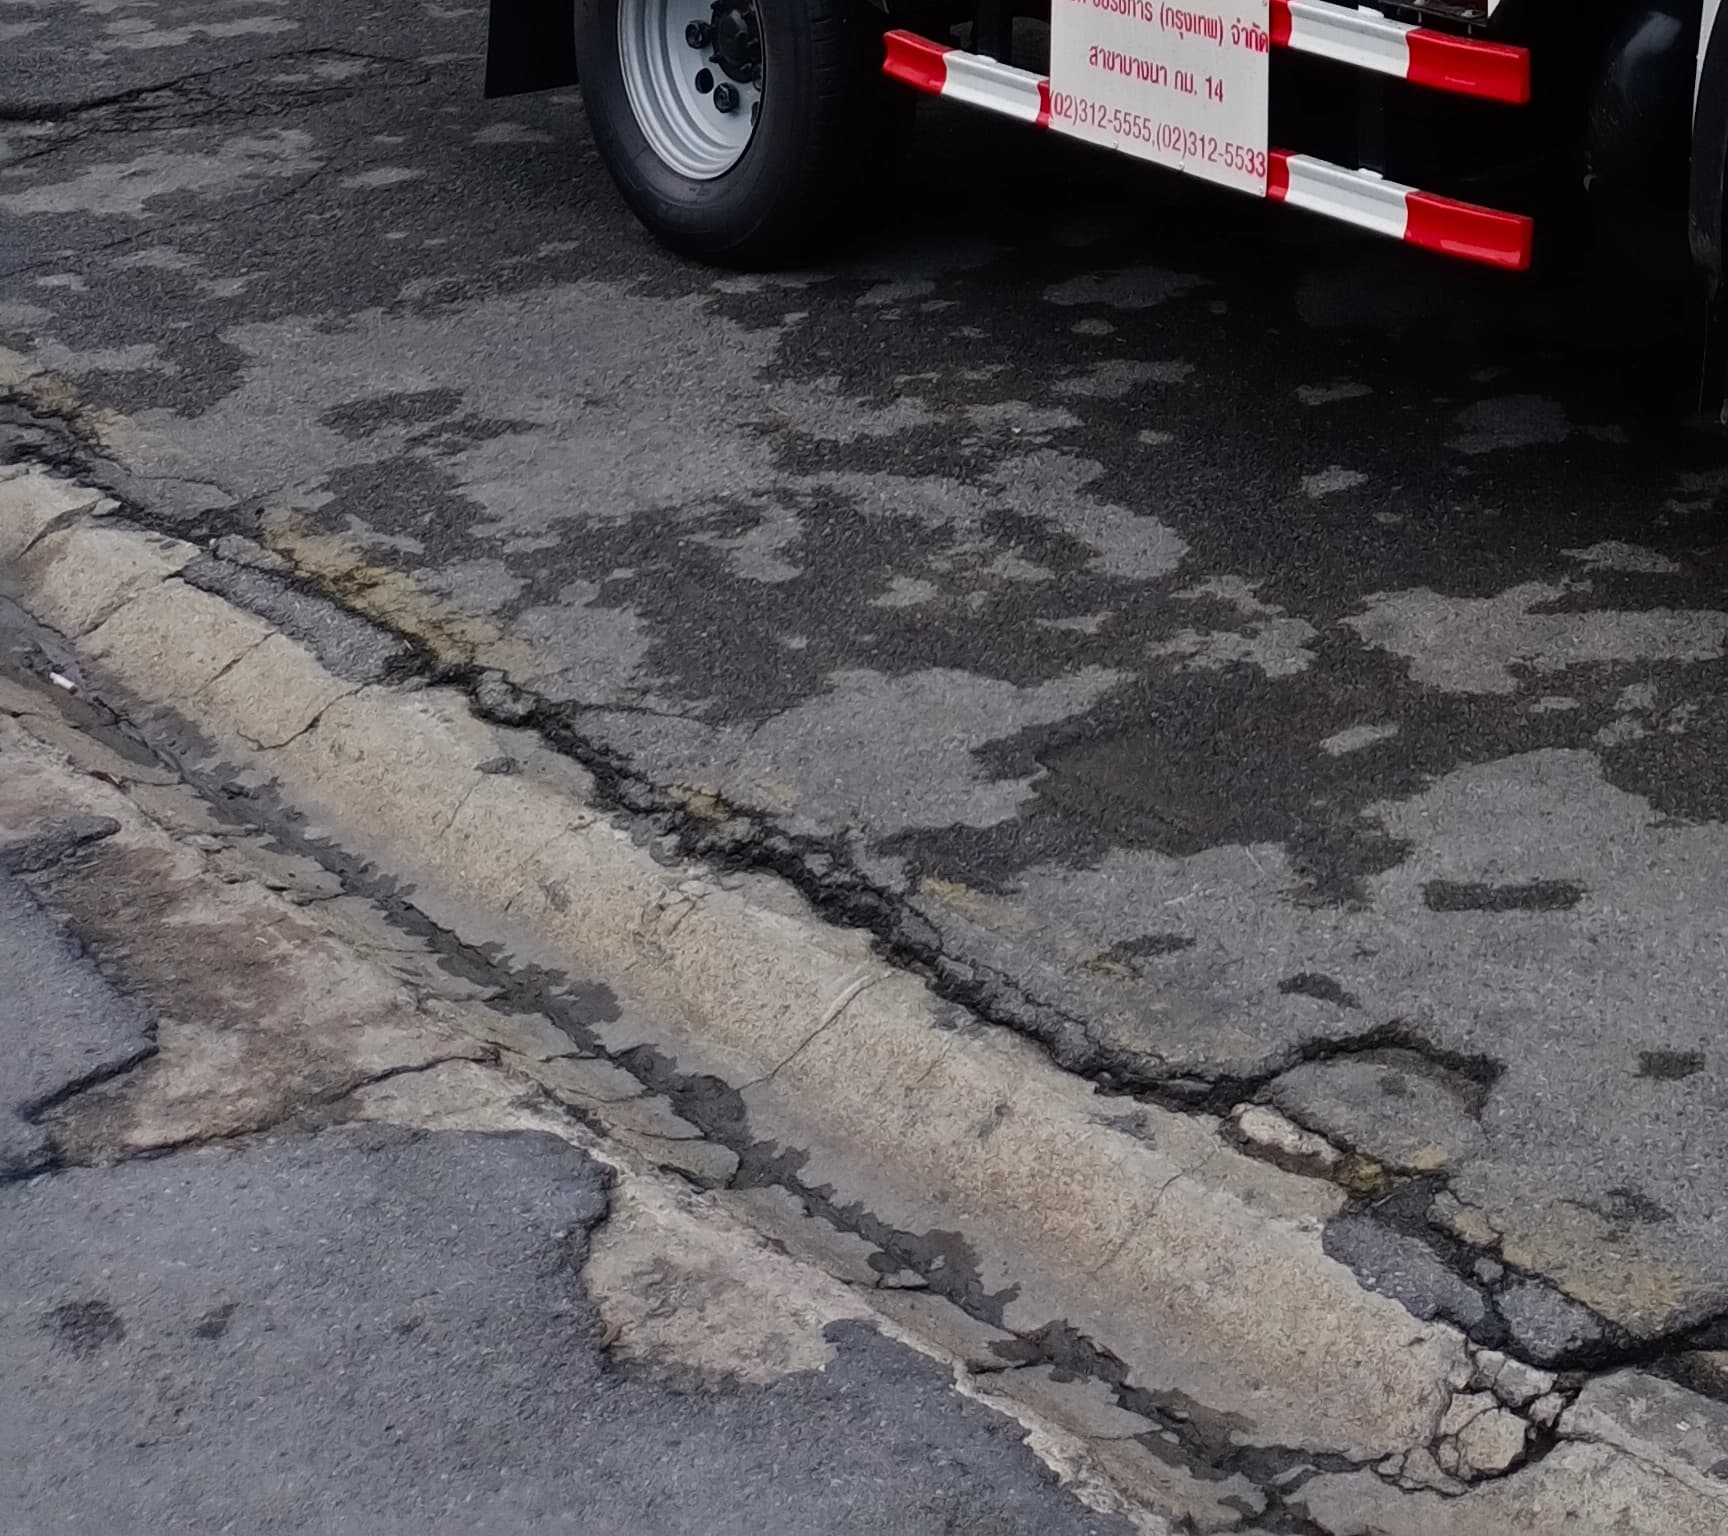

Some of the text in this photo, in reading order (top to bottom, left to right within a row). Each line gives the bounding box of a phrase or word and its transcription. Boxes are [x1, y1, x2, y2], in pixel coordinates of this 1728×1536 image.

[1159, 1, 1224, 47] (กรุงเทพ)
[1088, 44, 1224, 103] สาขาบางนา กม. 14
